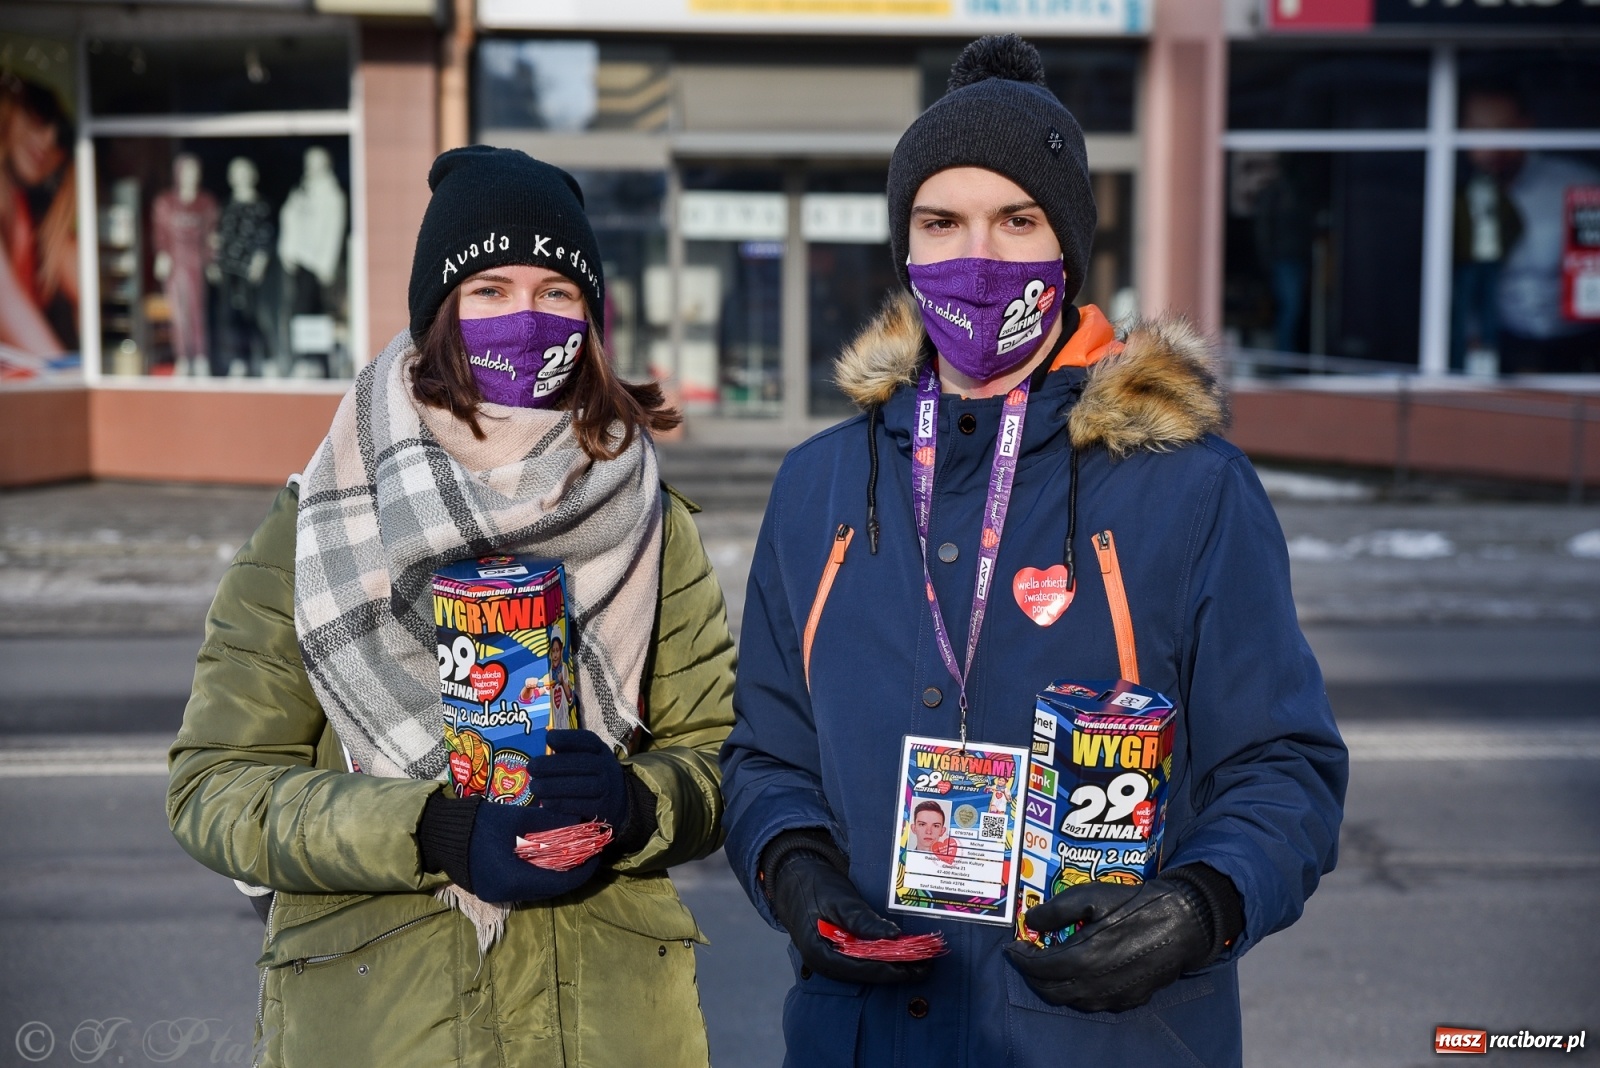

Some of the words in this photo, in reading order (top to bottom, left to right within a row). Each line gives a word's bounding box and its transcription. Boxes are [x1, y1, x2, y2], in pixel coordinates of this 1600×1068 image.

[442, 232, 510, 284] Avada
[999, 279, 1045, 338] 29
[1001, 322, 1038, 351] PLAY
[537, 332, 583, 378] 29
[921, 402, 931, 435] PLAY
[1002, 418, 1016, 454] PLAY
[978, 560, 988, 597] PLAY
[1017, 577, 1040, 590] wielka
[1040, 576, 1067, 588] orkiestr
[460, 708, 468, 721] z
[470, 700, 532, 735] radością
[914, 771, 943, 790] 29
[916, 752, 1016, 778] WYGRYWAMY
[1061, 773, 1149, 838] 29
[1065, 823, 1087, 836] 2021
[1088, 823, 1144, 840] FINAŁ
[1106, 849, 1118, 863] z
